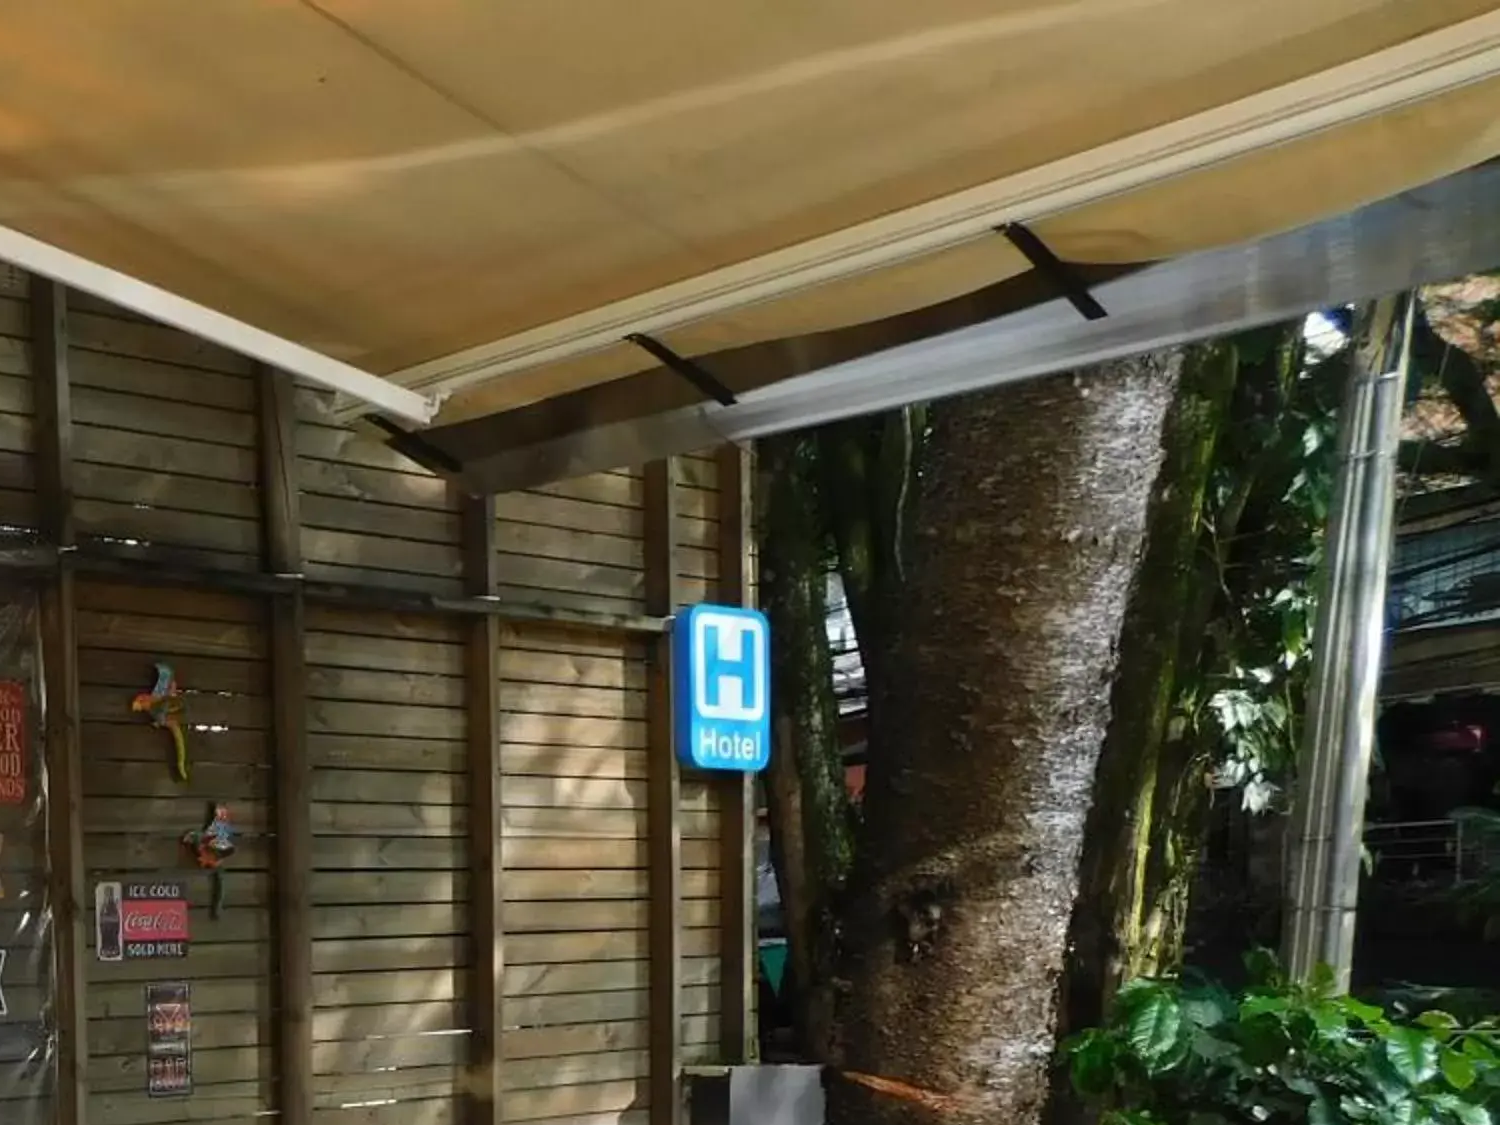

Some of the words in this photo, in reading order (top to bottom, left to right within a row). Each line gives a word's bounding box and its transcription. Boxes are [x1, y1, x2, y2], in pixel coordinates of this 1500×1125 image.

[700, 727, 762, 761] Hotel
[128, 885, 147, 897] ICE
[149, 884, 180, 897] COLD
[127, 943, 155, 956] SOLD
